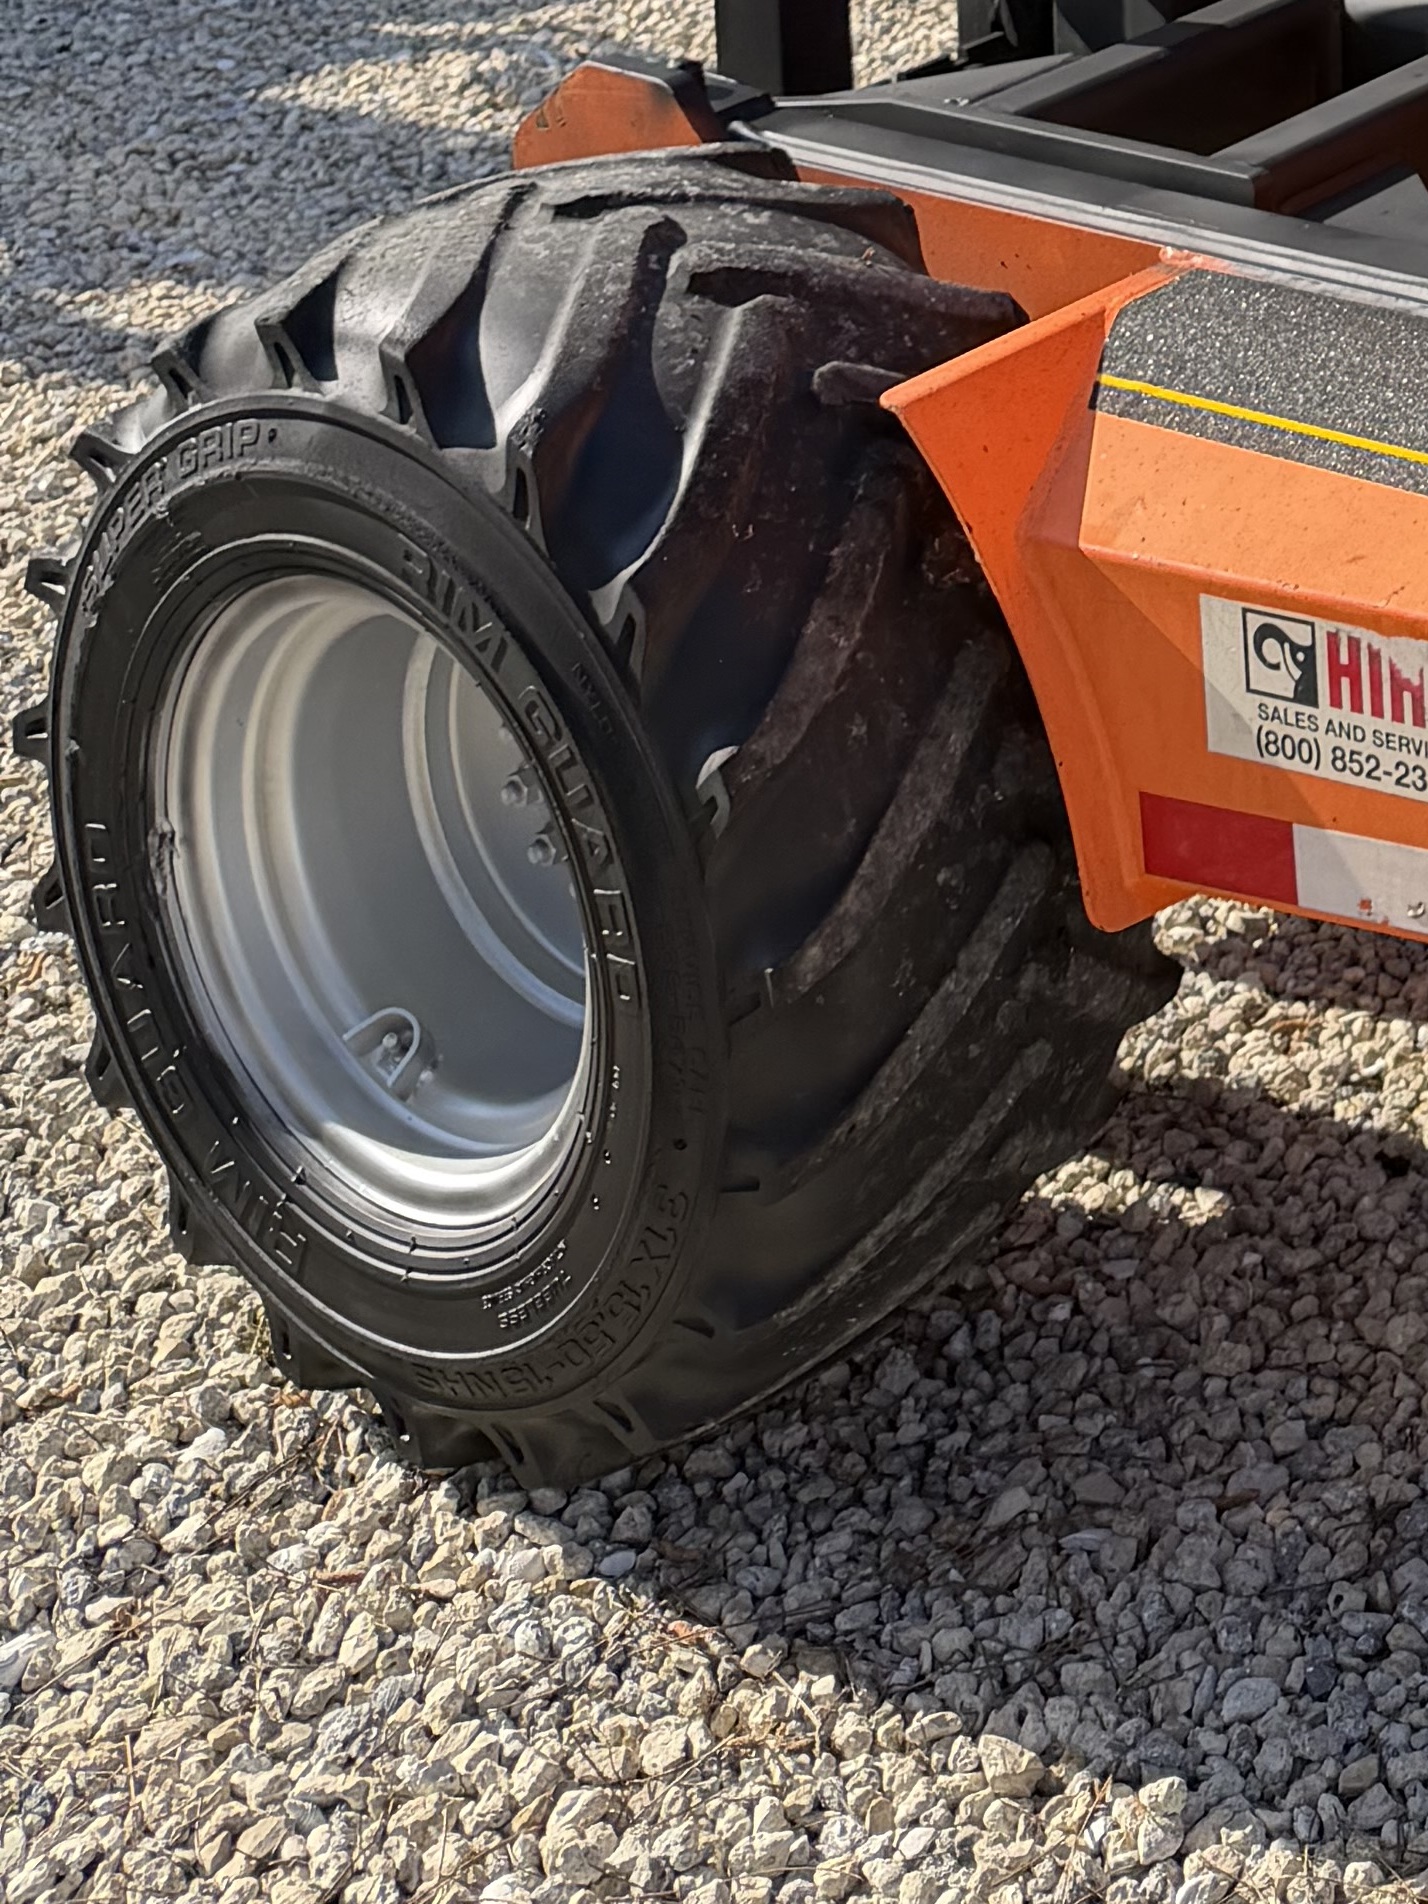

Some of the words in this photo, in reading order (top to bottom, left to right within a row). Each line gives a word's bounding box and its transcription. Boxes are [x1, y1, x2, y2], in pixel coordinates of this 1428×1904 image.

[177, 418, 261, 480] GRIP
[1257, 702, 1319, 732] SALES
[1325, 719, 1366, 744] AND
[1256, 724, 1321, 771] (800)
